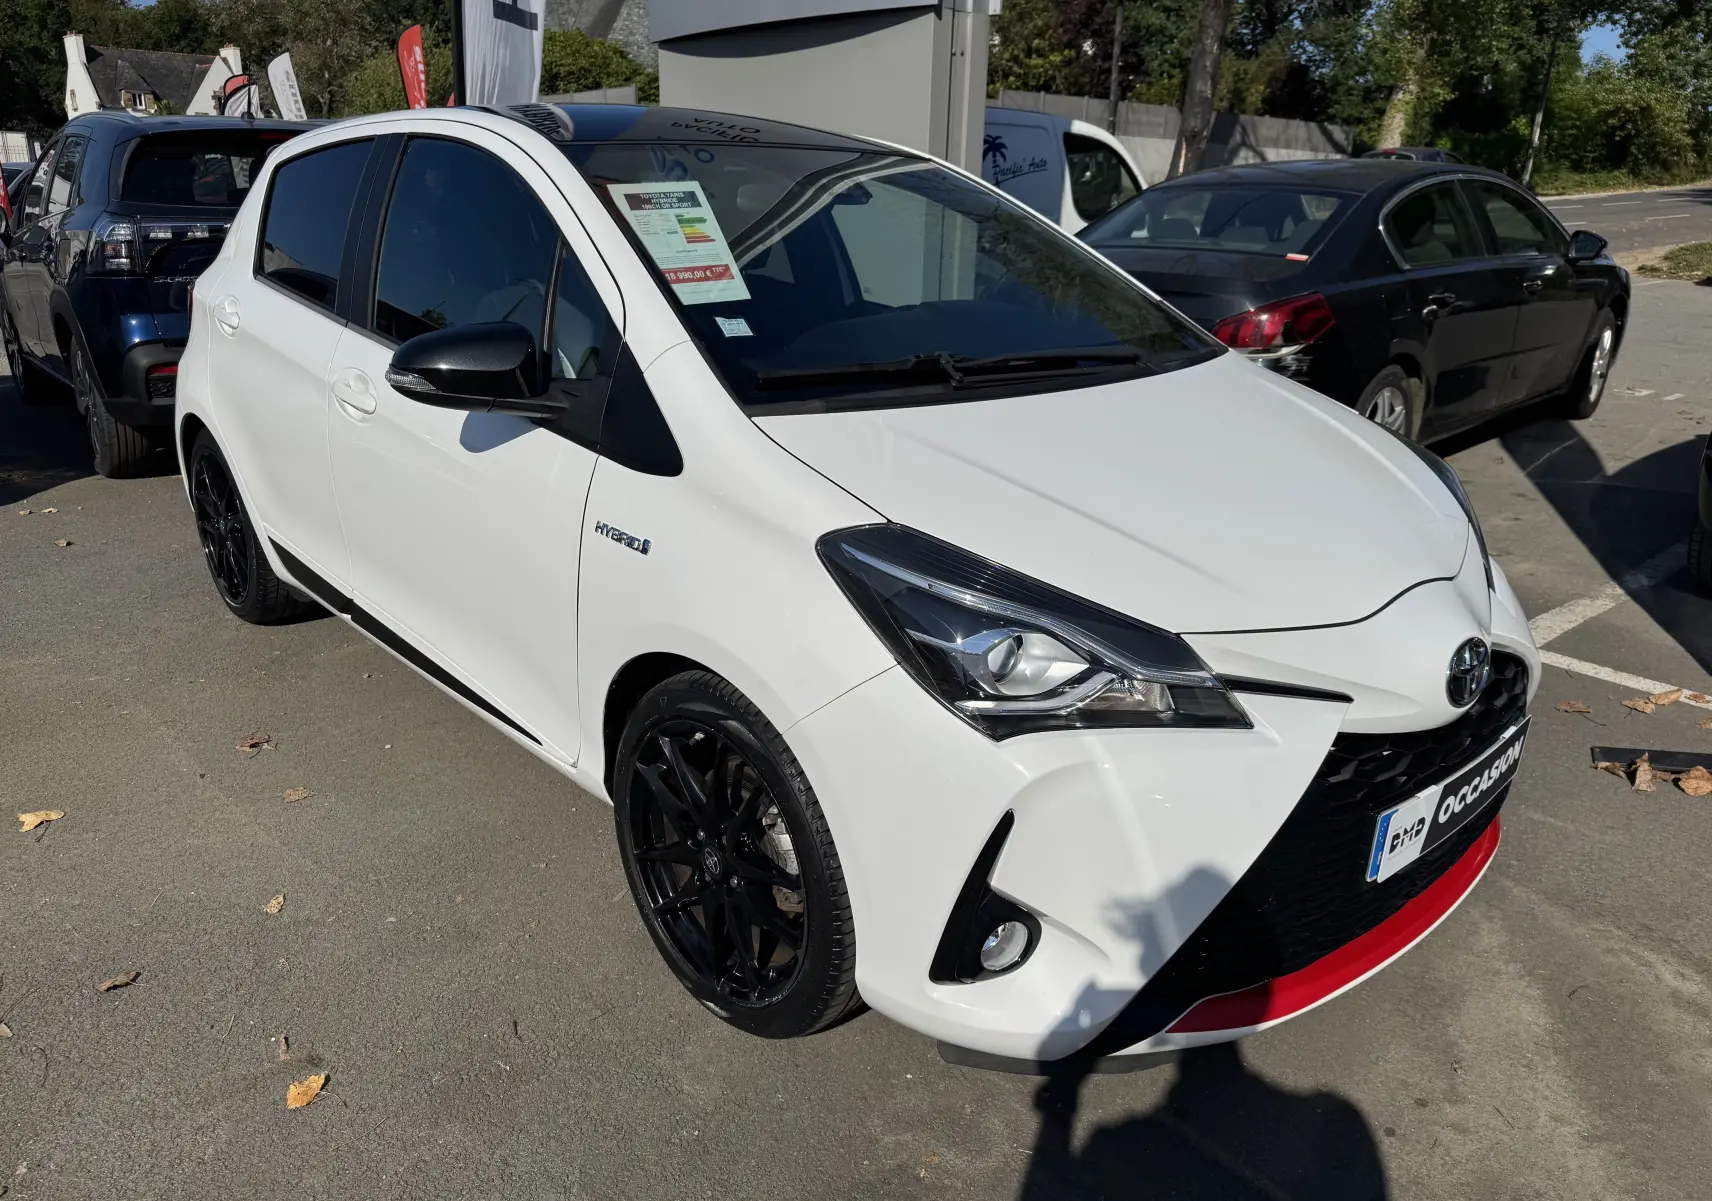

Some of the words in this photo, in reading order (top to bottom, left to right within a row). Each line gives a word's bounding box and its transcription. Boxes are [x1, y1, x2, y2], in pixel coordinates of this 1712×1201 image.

[1028, 157, 1047, 170] Auto
[154, 275, 198, 283] S-CROS
[665, 272, 676, 280] 18
[677, 271, 705, 280] 990,00
[595, 520, 642, 552] HYBRID
[1438, 734, 1525, 824] OCCASION
